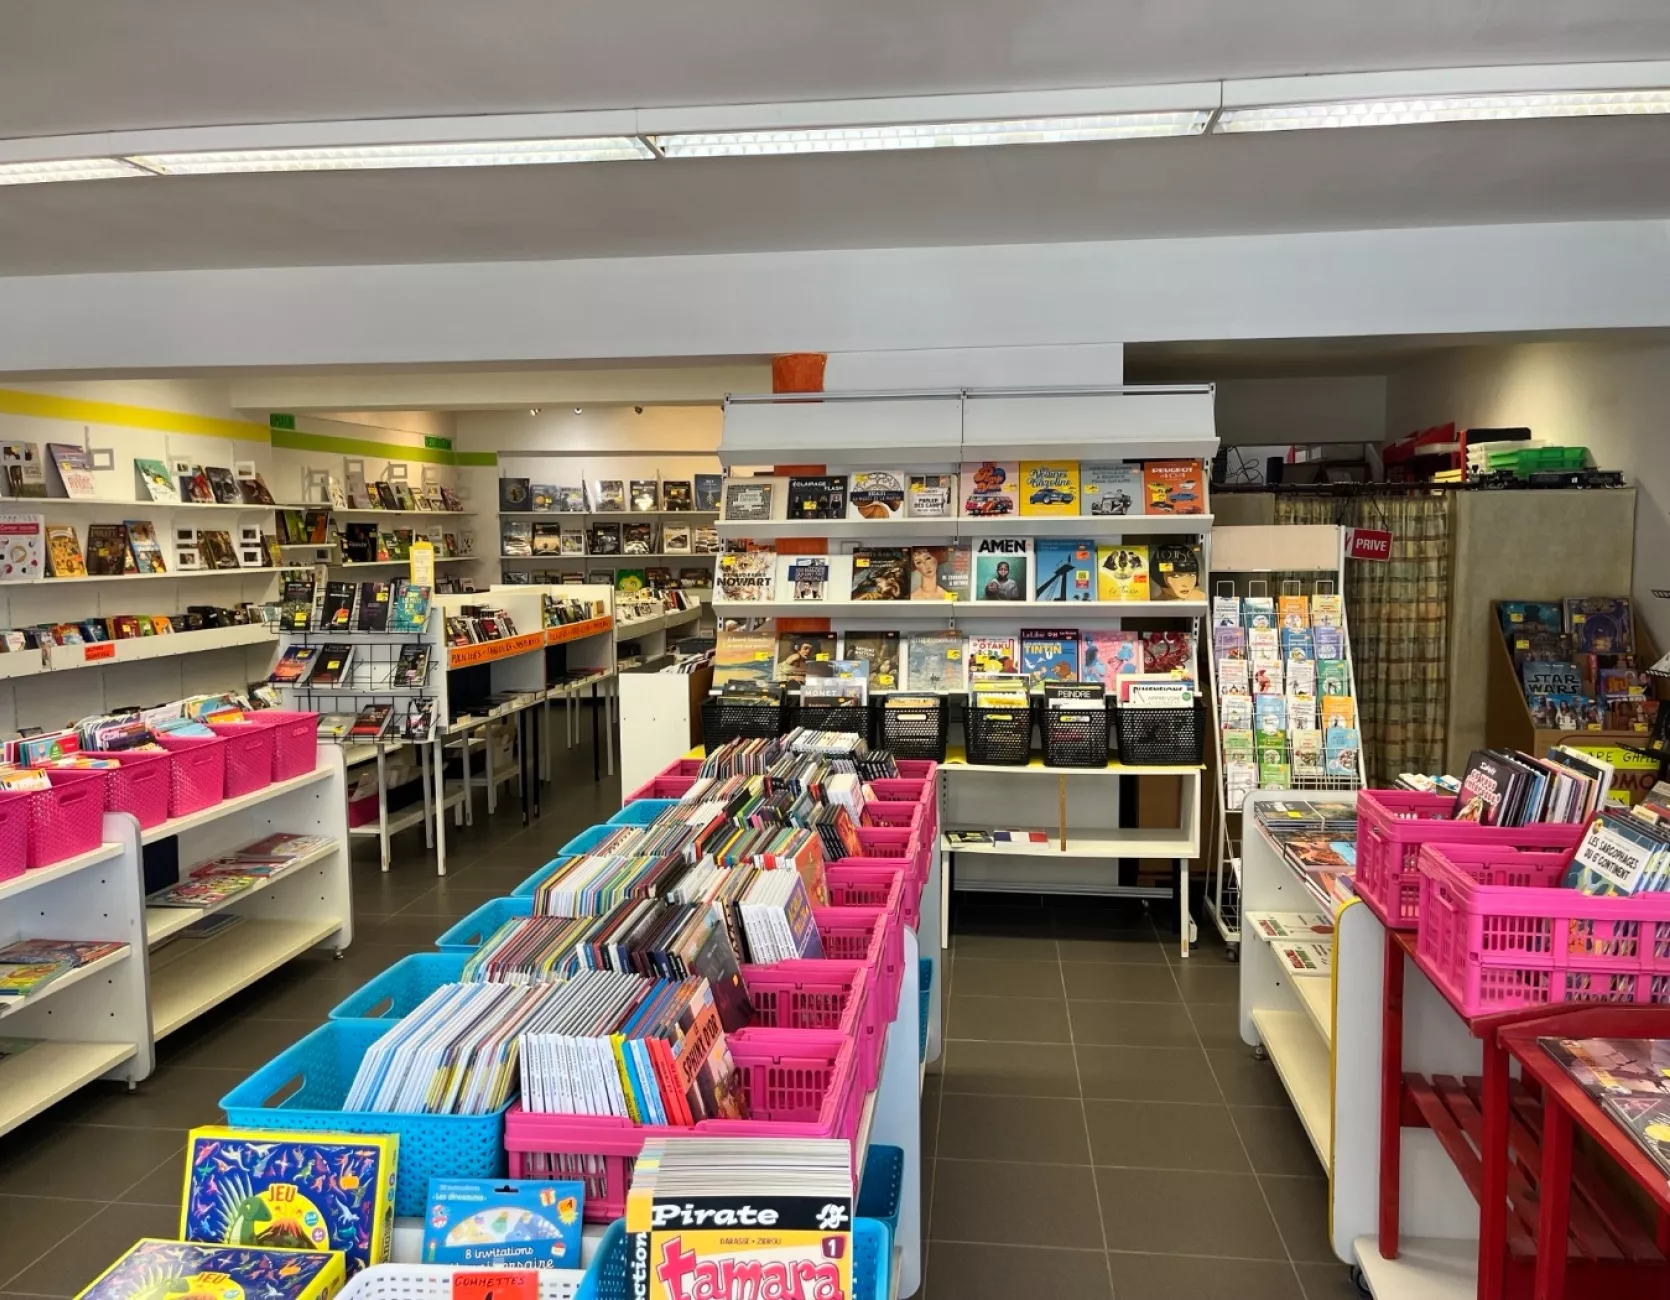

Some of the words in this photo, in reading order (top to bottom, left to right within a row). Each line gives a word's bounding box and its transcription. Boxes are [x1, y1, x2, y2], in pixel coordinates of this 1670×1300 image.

[978, 539, 1027, 553] AMEN
[1355, 537, 1388, 552] PRIVE
[716, 577, 772, 587] NOWART
[1023, 644, 1062, 654] TINTIN
[1527, 674, 1580, 685] STAR
[1057, 690, 1091, 698] PEINDRE
[1528, 684, 1581, 694] WARS
[1587, 835, 1600, 848] LES
[268, 1183, 297, 1203] JEU
[651, 1203, 780, 1226] Pirate
[464, 1248, 472, 1260] 8
[474, 1246, 534, 1259] invitations
[827, 1239, 837, 1257] 1
[631, 1231, 648, 1300] ction
[656, 1235, 845, 1300] tamara
[196, 1271, 228, 1285] JEU
